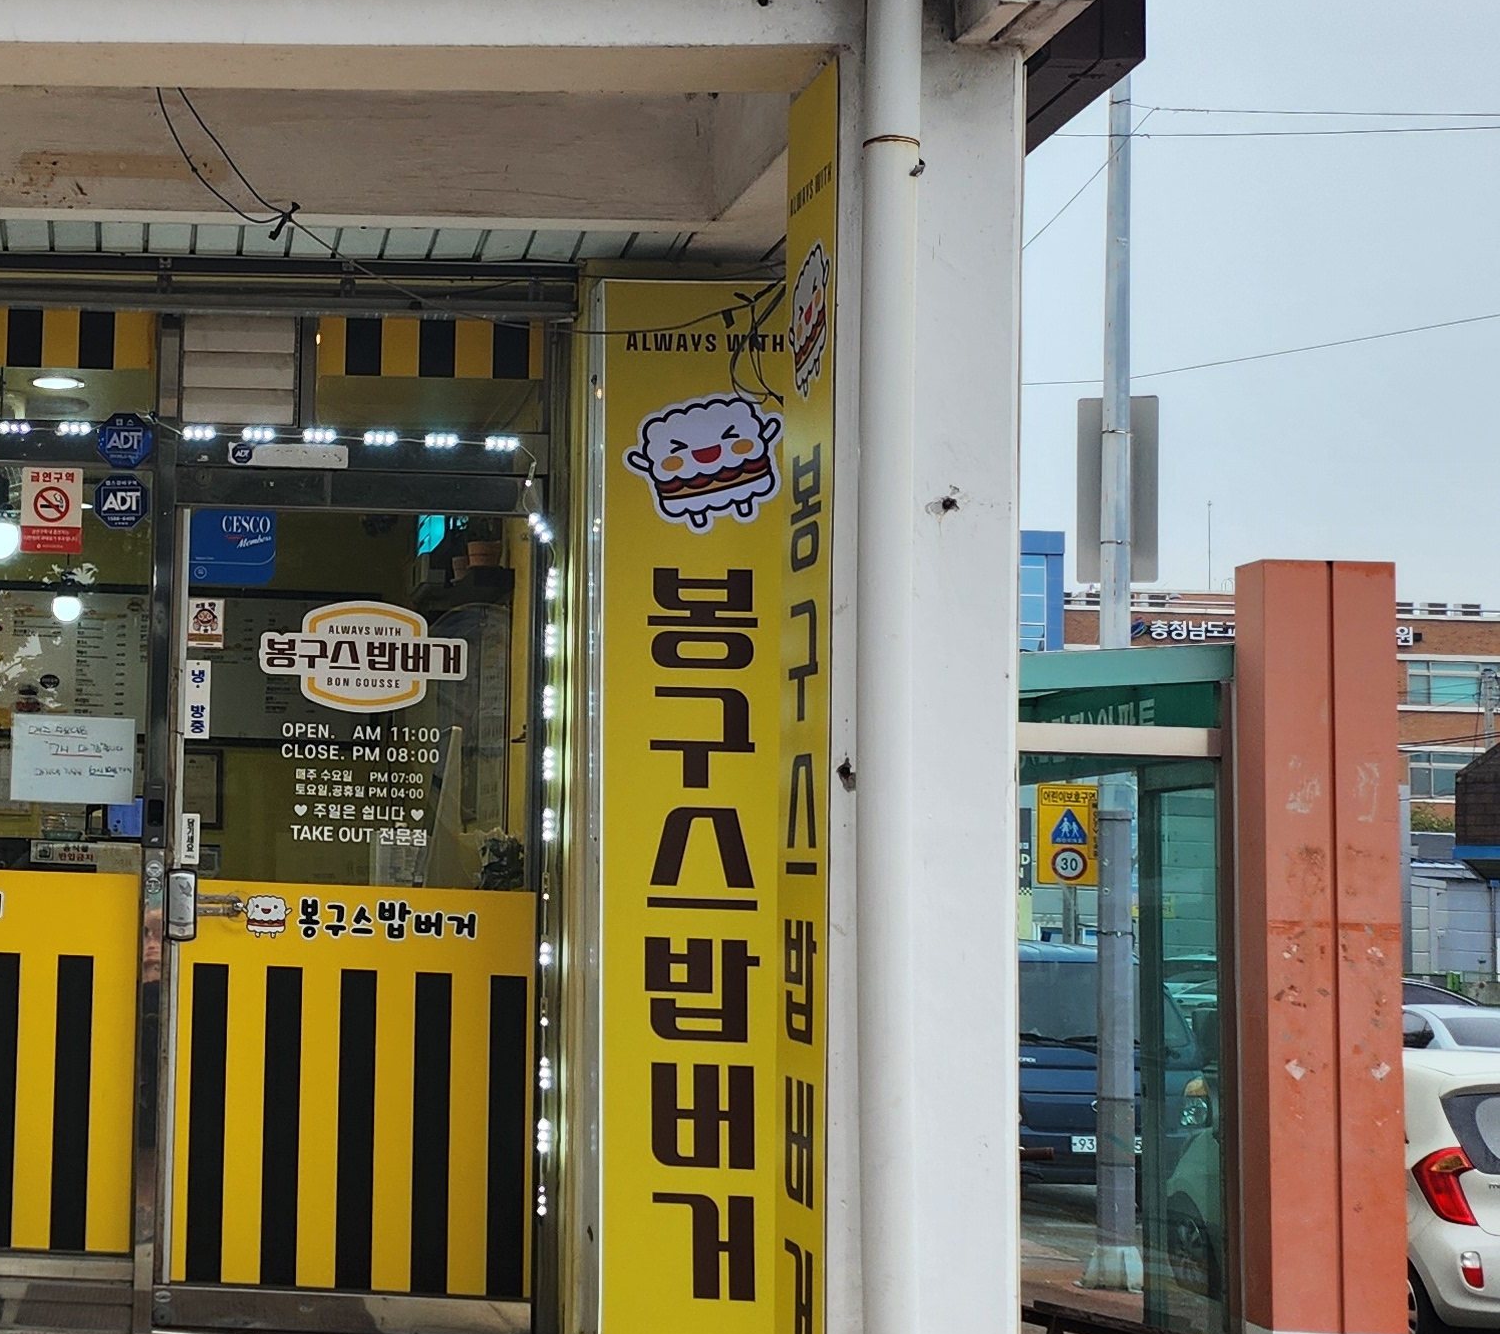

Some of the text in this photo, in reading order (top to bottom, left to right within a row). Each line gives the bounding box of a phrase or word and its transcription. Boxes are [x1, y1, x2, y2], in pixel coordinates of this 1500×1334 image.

[789, 161, 832, 218] ALWAYS WITH
[625, 331, 786, 354] ALWAYS WITH
[106, 430, 143, 450] ADT
[30, 471, 75, 484] 금연구역
[102, 490, 141, 512] ADT
[221, 515, 271, 534] CESCO
[236, 534, 272, 549] Members
[328, 624, 402, 637] ALWAYS WITH
[326, 677, 401, 689] BON GOUSSE
[282, 722, 440, 743] OPEN. AM 11:00
[281, 743, 440, 764] CLOSE. PM 08:00
[295, 768, 424, 784] 매주 수요일 PM 07:00
[295, 783, 424, 800] 토요일,공휴일 PM 04:00
[313, 803, 406, 822] 주일은 쉽니다
[290, 824, 428, 847] TAKE OUT 전문점
[58, 852, 94, 862] 반입금지
[1060, 857, 1079, 872] 30
[297, 896, 478, 941] 봉구스밥버거
[644, 567, 761, 1303] 봉구스밥버거
